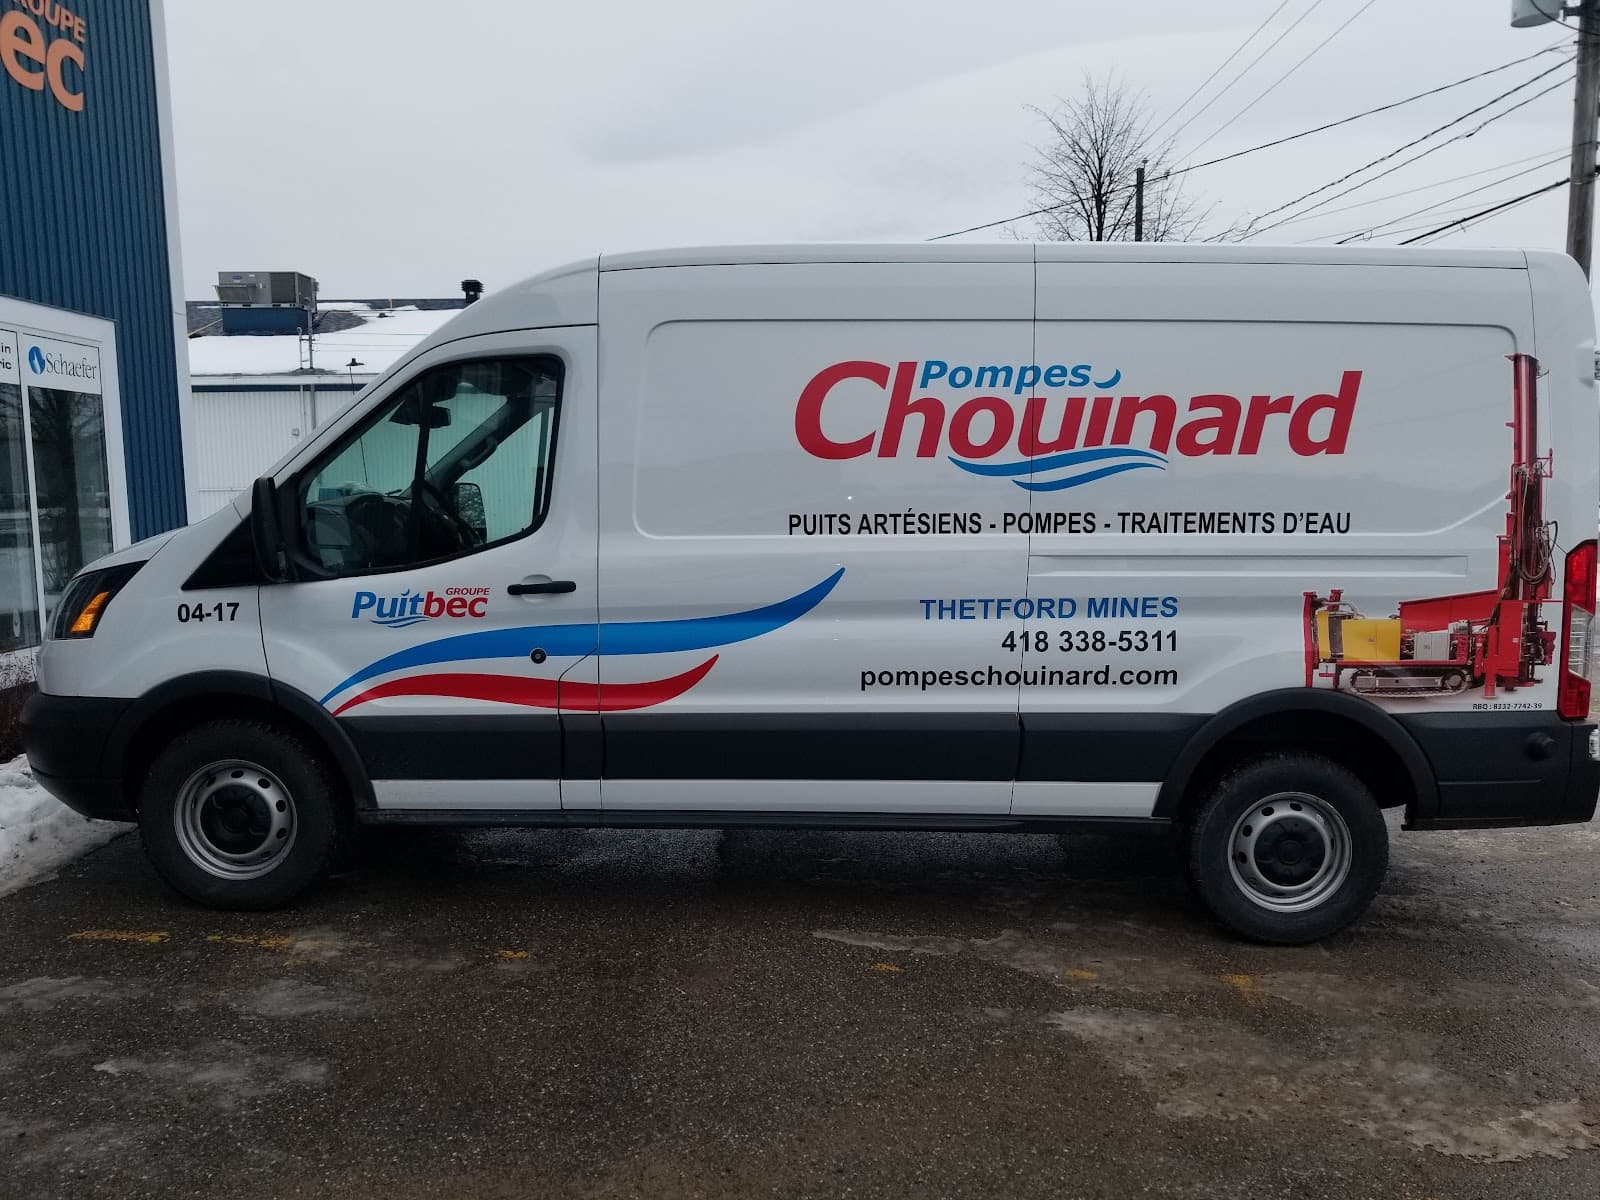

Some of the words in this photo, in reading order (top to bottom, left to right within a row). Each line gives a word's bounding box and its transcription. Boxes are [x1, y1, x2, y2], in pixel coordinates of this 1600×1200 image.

[14, 0, 86, 43] OUPE
[46, 352, 97, 379] Schaefer
[920, 360, 1092, 394] Pompes
[794, 360, 1363, 460] Chouinard
[789, 513, 852, 536] PUITS
[858, 508, 983, 535] ARTÉSIENS
[1002, 512, 1097, 534] POMPES
[1117, 512, 1275, 534] TRAITEMENTS
[352, 589, 489, 619] Puitbec
[446, 587, 490, 596] GROUPE
[177, 602, 240, 623] 04-17
[919, 598, 1077, 620] THETFORD
[1087, 597, 1179, 618] MINES
[1001, 631, 1049, 652] 418
[1058, 630, 1178, 652] 338-5311
[860, 665, 1178, 691] pompeschouinard.com
